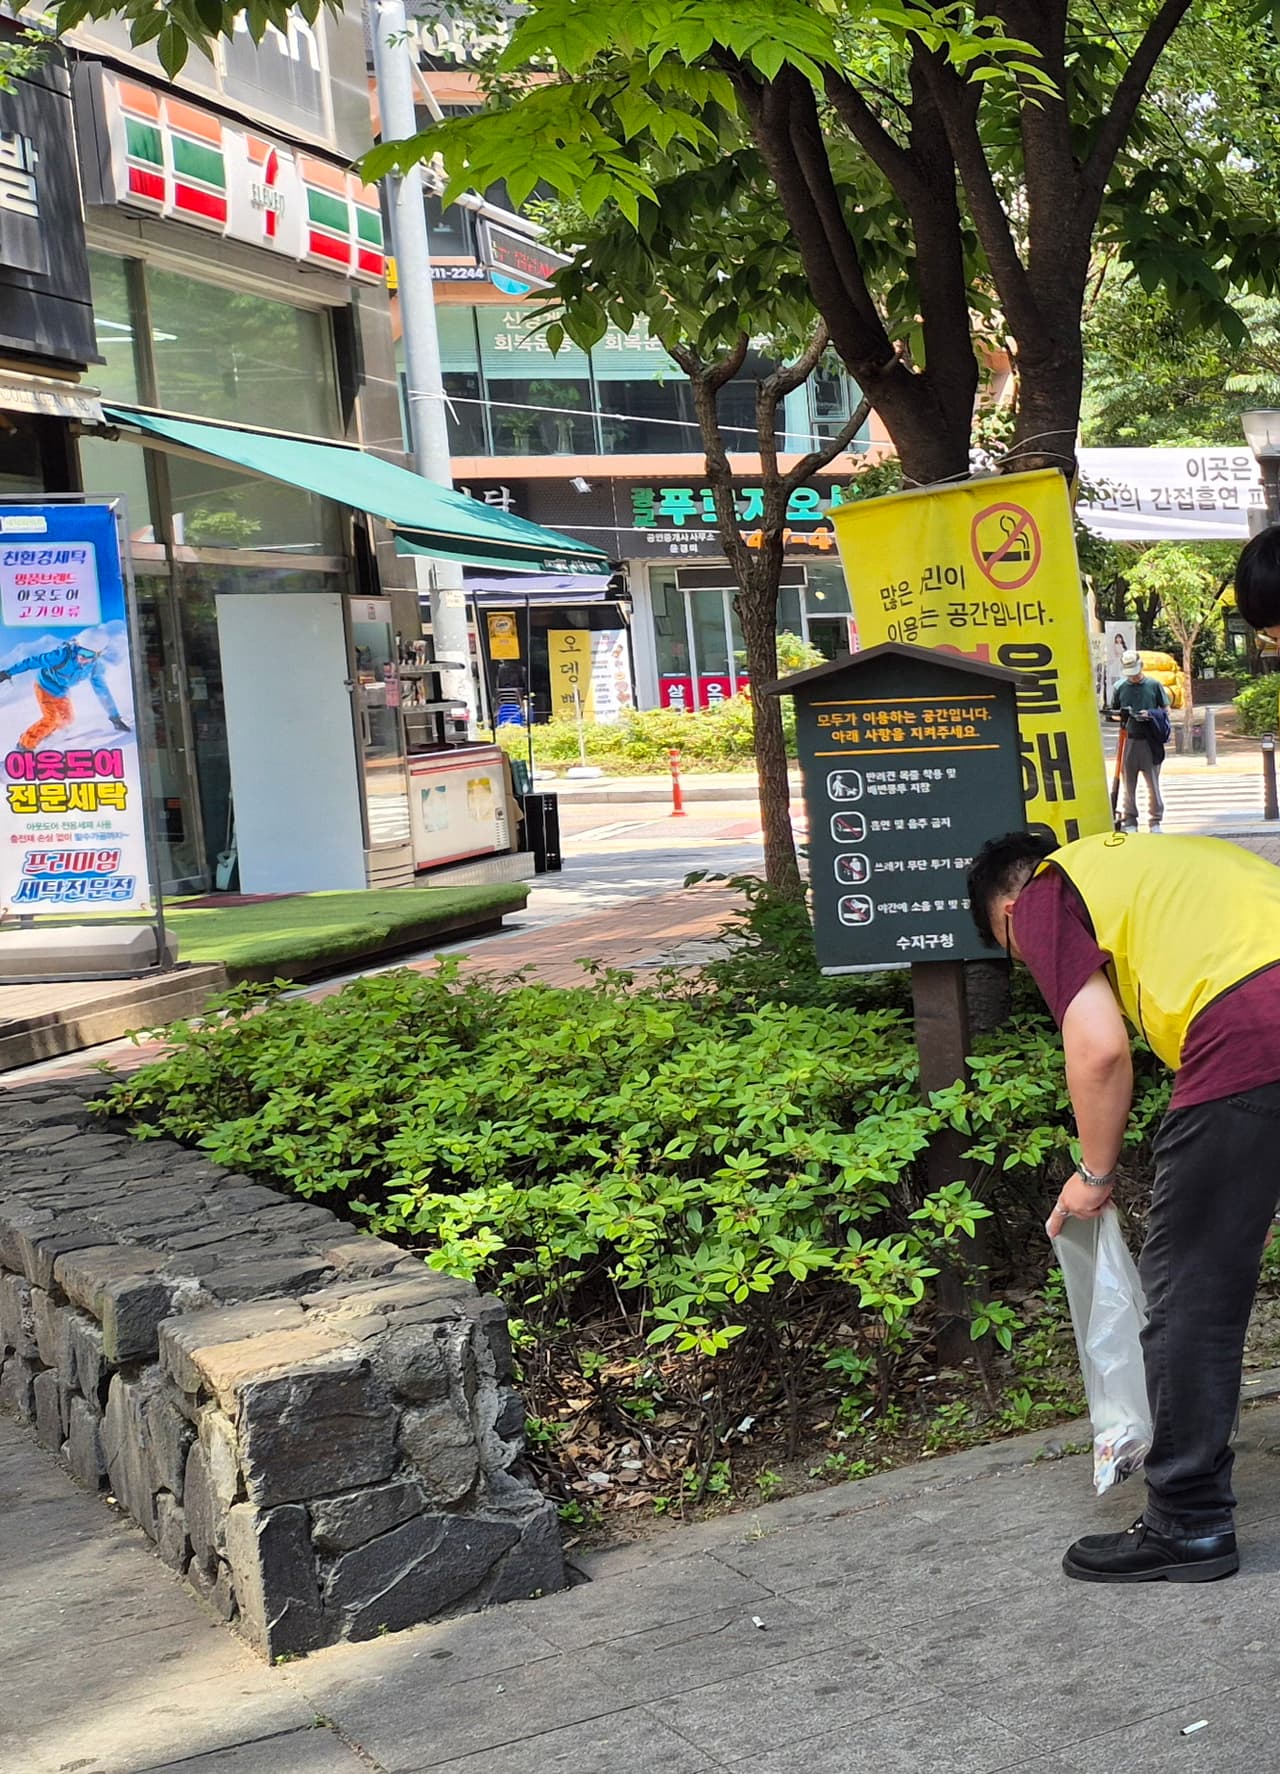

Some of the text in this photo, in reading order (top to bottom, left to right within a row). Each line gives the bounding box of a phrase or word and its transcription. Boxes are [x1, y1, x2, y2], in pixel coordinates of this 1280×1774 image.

[1187, 456, 1252, 481] 이곳은
[1079, 488, 1141, 512] 인의
[1151, 486, 1240, 512] 간접흡연
[3, 549, 87, 566] 친환경세탁
[880, 580, 914, 613] 많은
[946, 599, 1055, 629] 공간입니다.
[817, 706, 993, 728] 모두가 이용하는 공간입니다.
[831, 724, 982, 744] 아래 사항을 지켜주세요.
[5, 749, 125, 781] 아웃도어
[8, 781, 128, 813] 전문세탁
[894, 818, 905, 831] 및
[907, 817, 929, 830] 음주
[930, 816, 952, 829] 금지
[24, 850, 120, 875] 프리미엄
[873, 860, 904, 873] 쓰레기
[907, 859, 928, 871] 무단
[930, 858, 951, 870] 투기
[14, 877, 134, 903] 세탁전문점
[877, 901, 908, 915] 야간에
[896, 932, 955, 951] 수지구청
